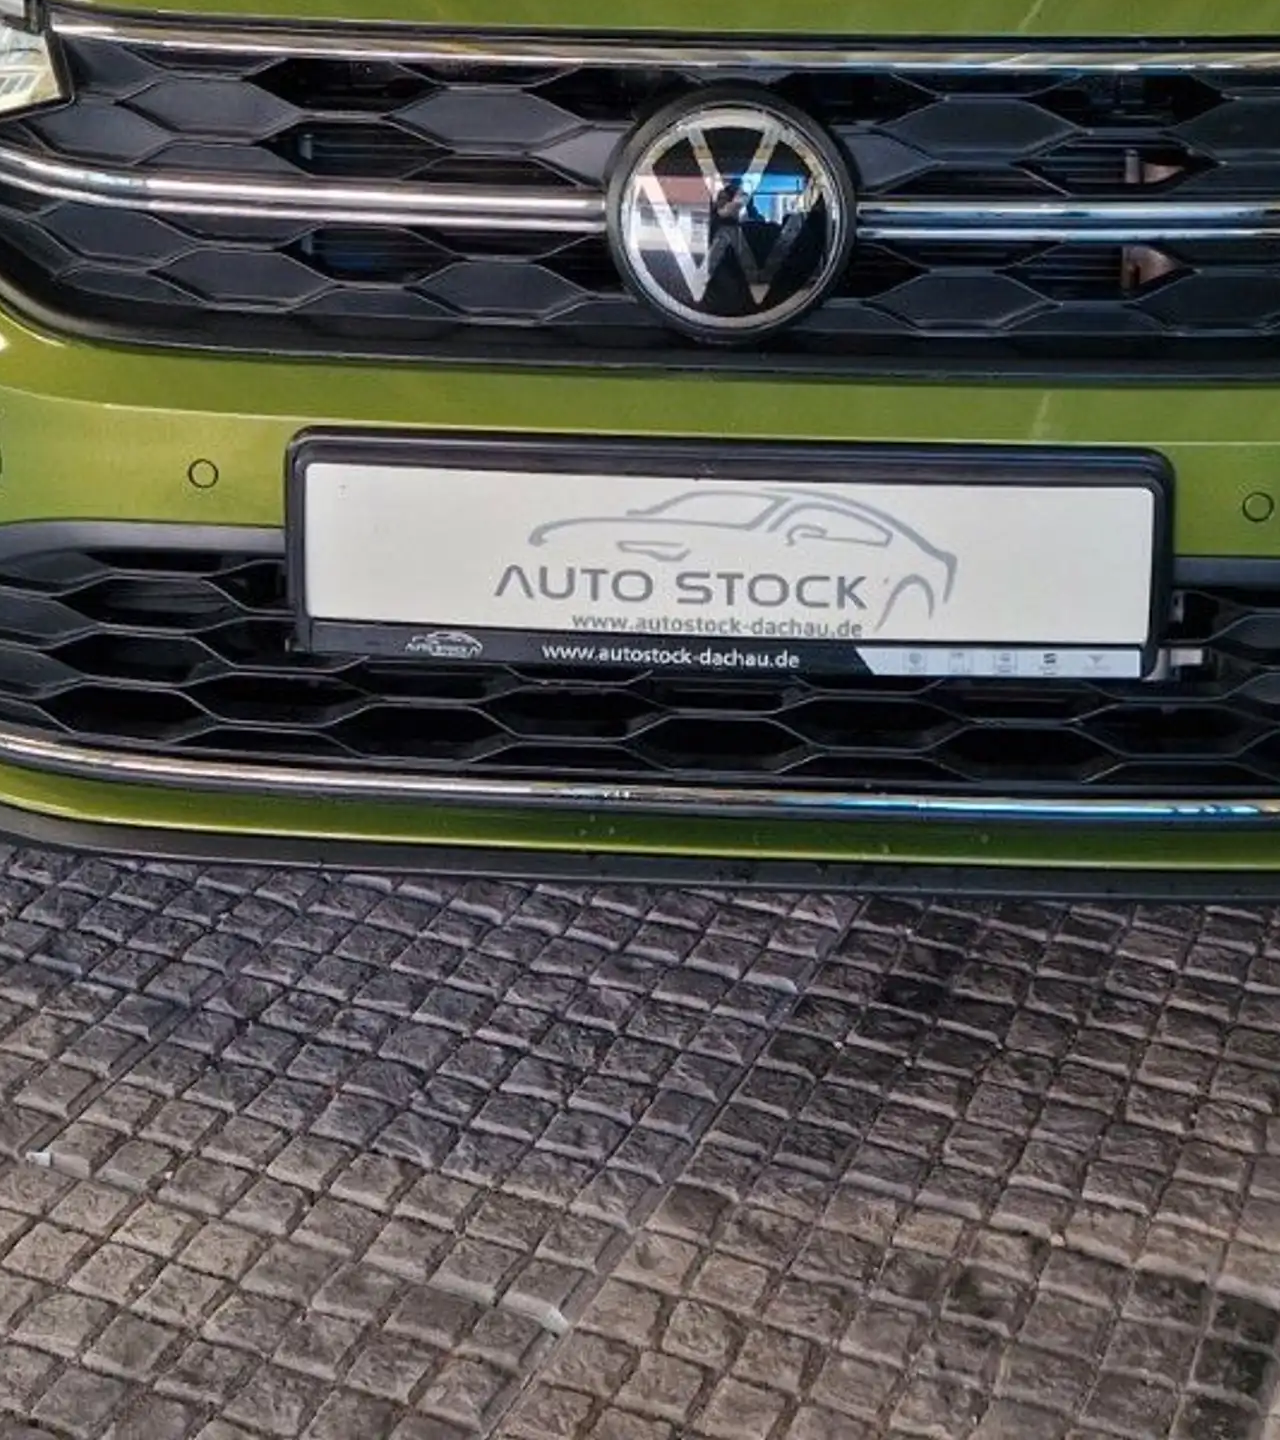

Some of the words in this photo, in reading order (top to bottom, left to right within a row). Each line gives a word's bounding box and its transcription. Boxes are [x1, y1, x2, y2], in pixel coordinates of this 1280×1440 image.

[494, 564, 653, 603] AUTO
[675, 571, 869, 610] STOCK
[572, 614, 863, 639] www.autostock-dachau.de
[542, 643, 800, 670] www.autostock-dachau.de
